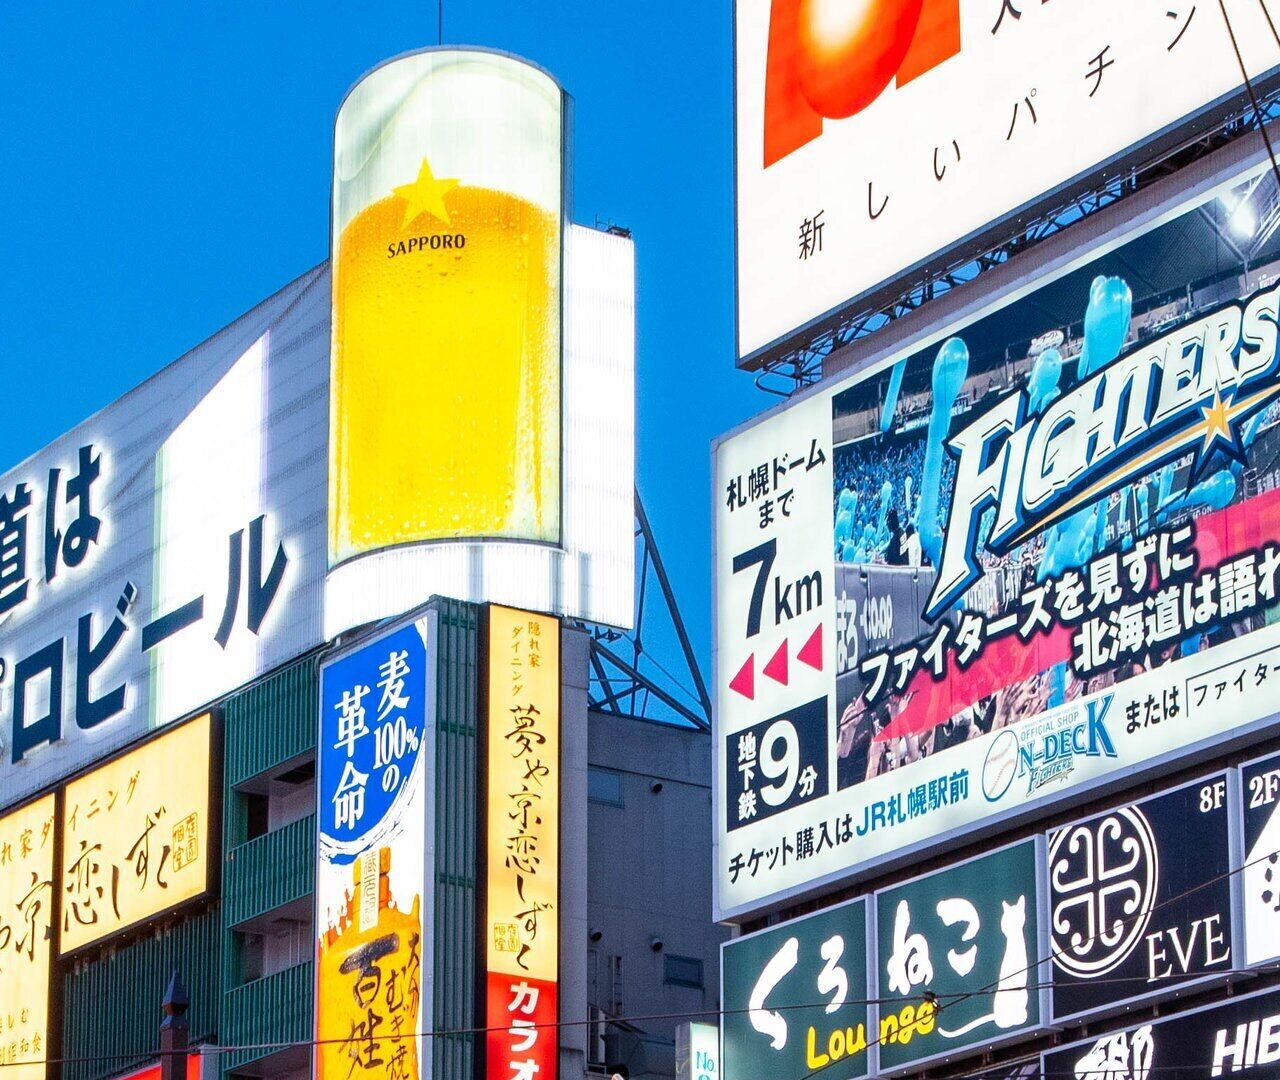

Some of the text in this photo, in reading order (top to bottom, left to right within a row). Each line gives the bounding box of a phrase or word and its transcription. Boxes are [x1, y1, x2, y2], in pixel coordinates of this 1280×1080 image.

[387, 232, 466, 260] SAPPORO
[726, 438, 826, 511] 札幌ドーム
[758, 488, 794, 528] まで
[528, 620, 543, 668] 隠れ家
[862, 525, 1195, 702] ファイターズを見ずに
[510, 625, 524, 698] ダイニング
[1020, 721, 1054, 742] OFFICIAL
[1057, 711, 1079, 728] SHOP
[1125, 688, 1181, 733] または
[333, 686, 370, 831] 革命
[736, 734, 756, 819] 地下鉄
[1200, 784, 1226, 814] 8F
[749, 895, 981, 1052] くろねこ
[1147, 914, 1229, 983] EVE
[696, 1051, 716, 1072] No.
[805, 998, 936, 1071] Lounge
